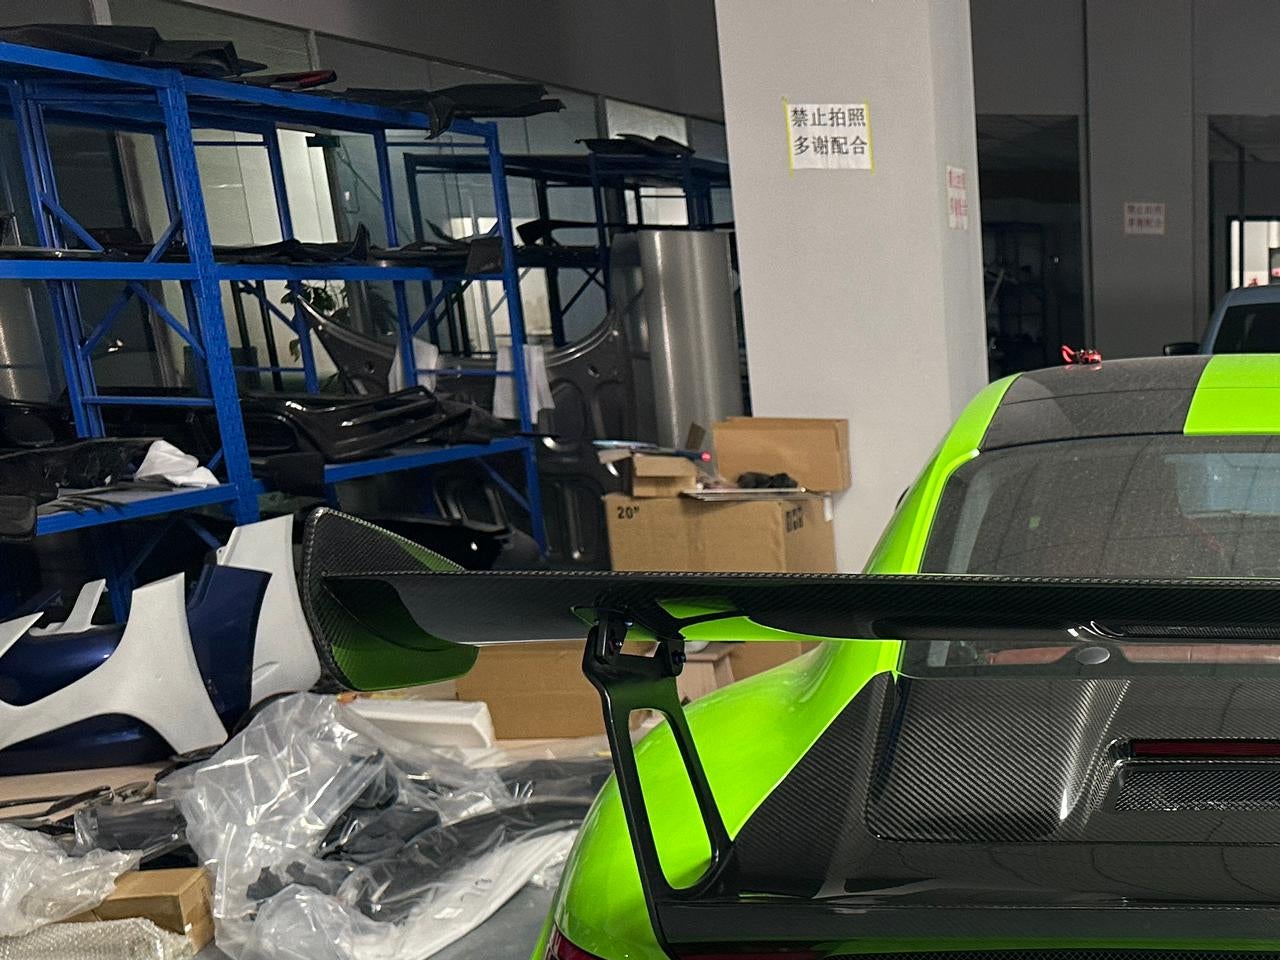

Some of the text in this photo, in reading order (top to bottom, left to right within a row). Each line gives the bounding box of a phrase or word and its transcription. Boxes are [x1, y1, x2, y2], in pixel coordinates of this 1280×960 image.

[791, 107, 866, 127] 禁止拍照
[793, 135, 867, 155] 多谢配合
